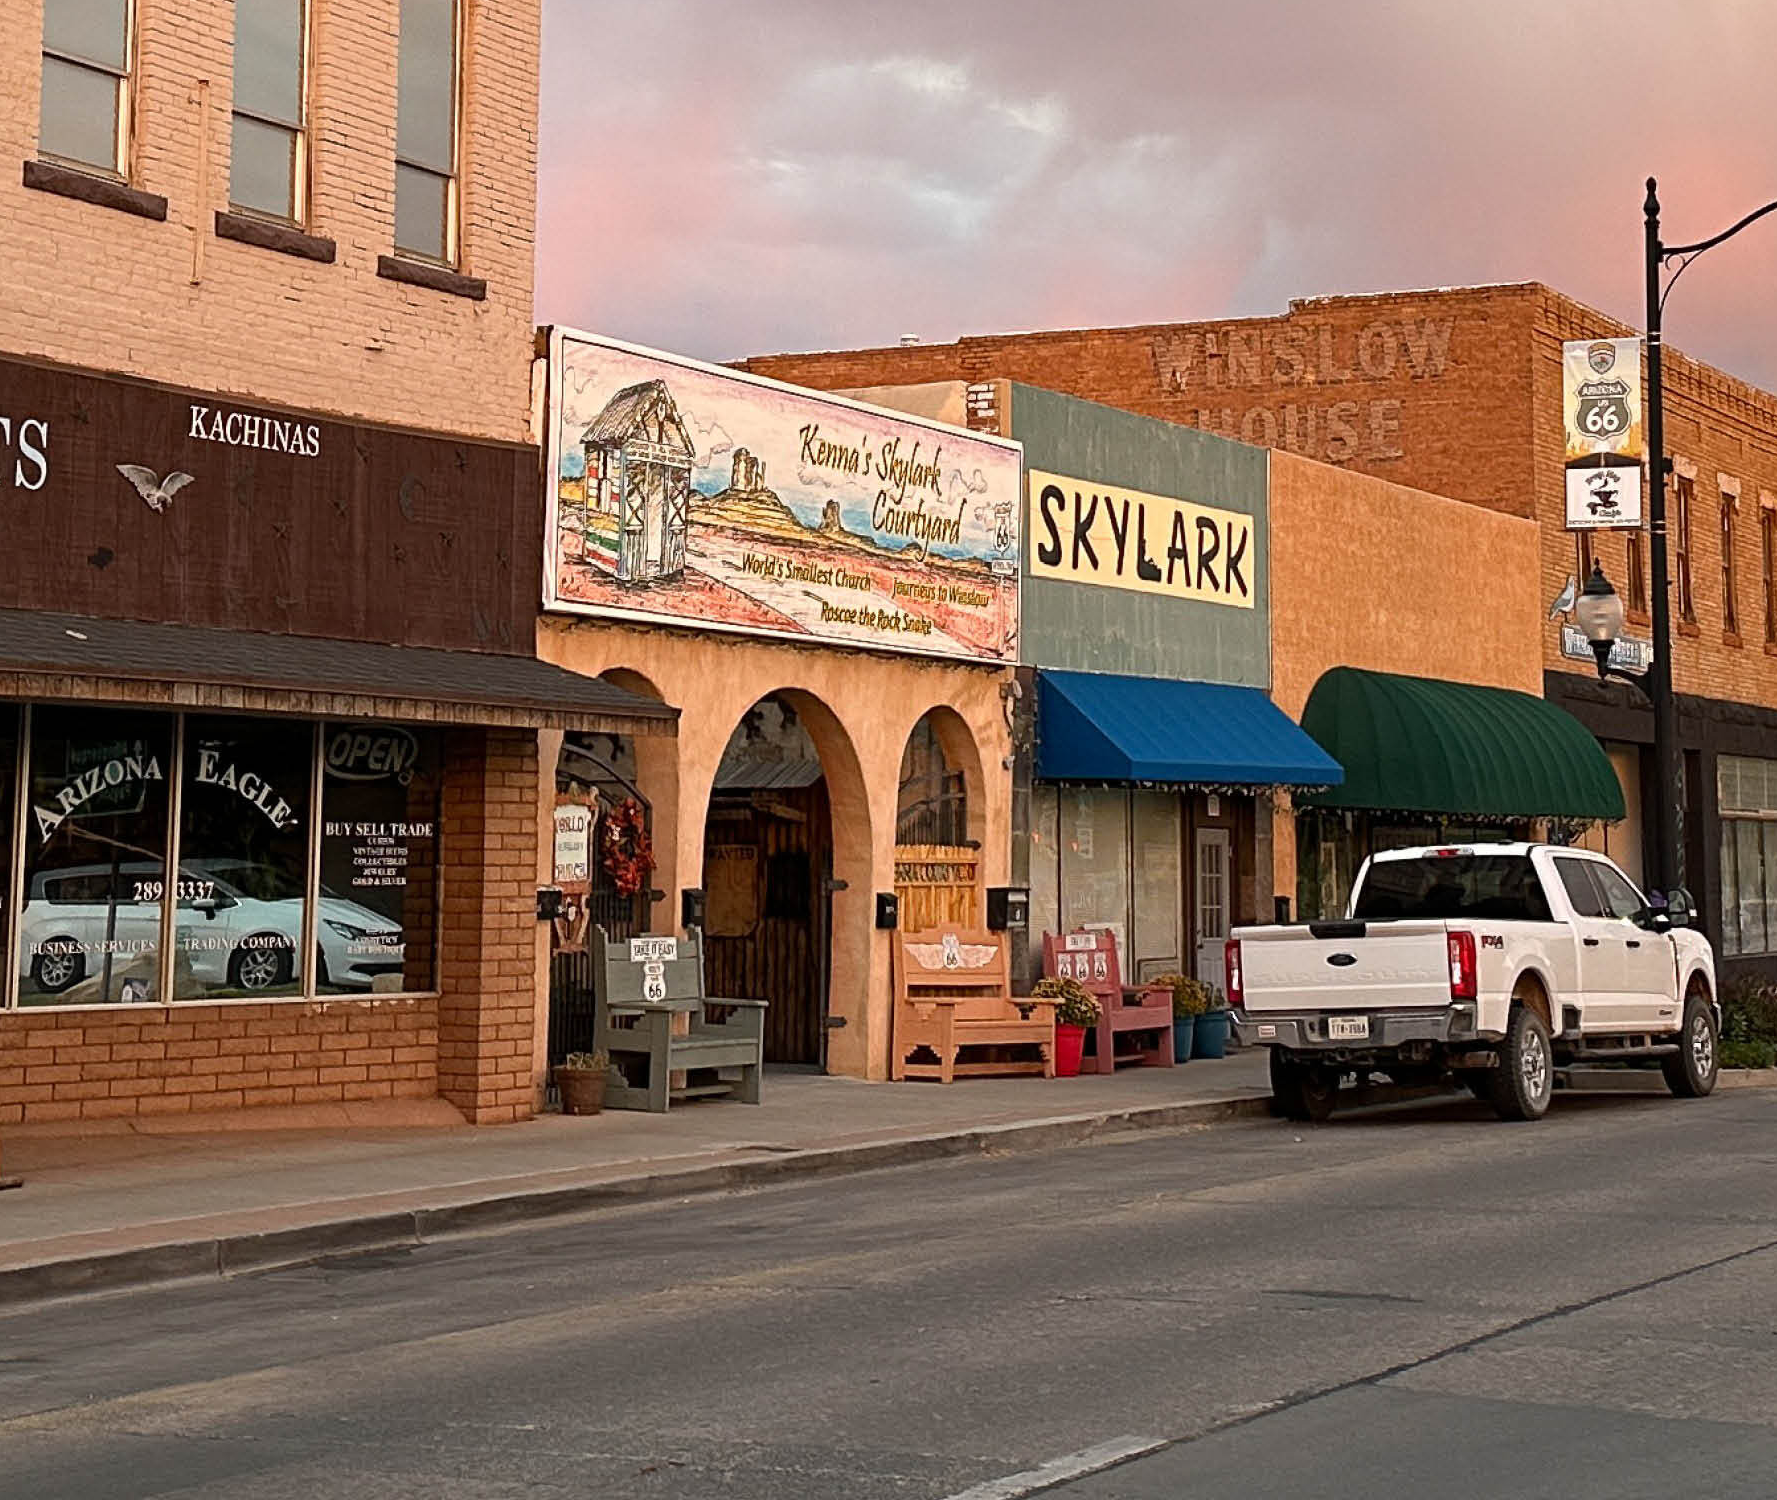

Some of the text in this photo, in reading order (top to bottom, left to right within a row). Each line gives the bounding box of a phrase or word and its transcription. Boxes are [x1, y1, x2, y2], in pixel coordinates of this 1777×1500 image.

[1151, 315, 1456, 399] WINSLOW
[189, 405, 320, 457] KACHINAS
[1586, 405, 1620, 432] 66
[799, 424, 942, 505] Kenna's Skylark
[872, 490, 967, 562] Courtyard
[1036, 482, 1249, 597] SKYLARK
[742, 552, 871, 591] World's Smallest Church
[859, 608, 875, 627] the
[329, 732, 408, 773] OPEN
[34, 749, 292, 844] ARIZONA EAGLE
[326, 822, 434, 837] BUY SELL TRADE
[134, 882, 163, 900] 289
[29, 938, 156, 955] BUSINESS SERVICES
[184, 935, 298, 950] TRADING COMPANY
